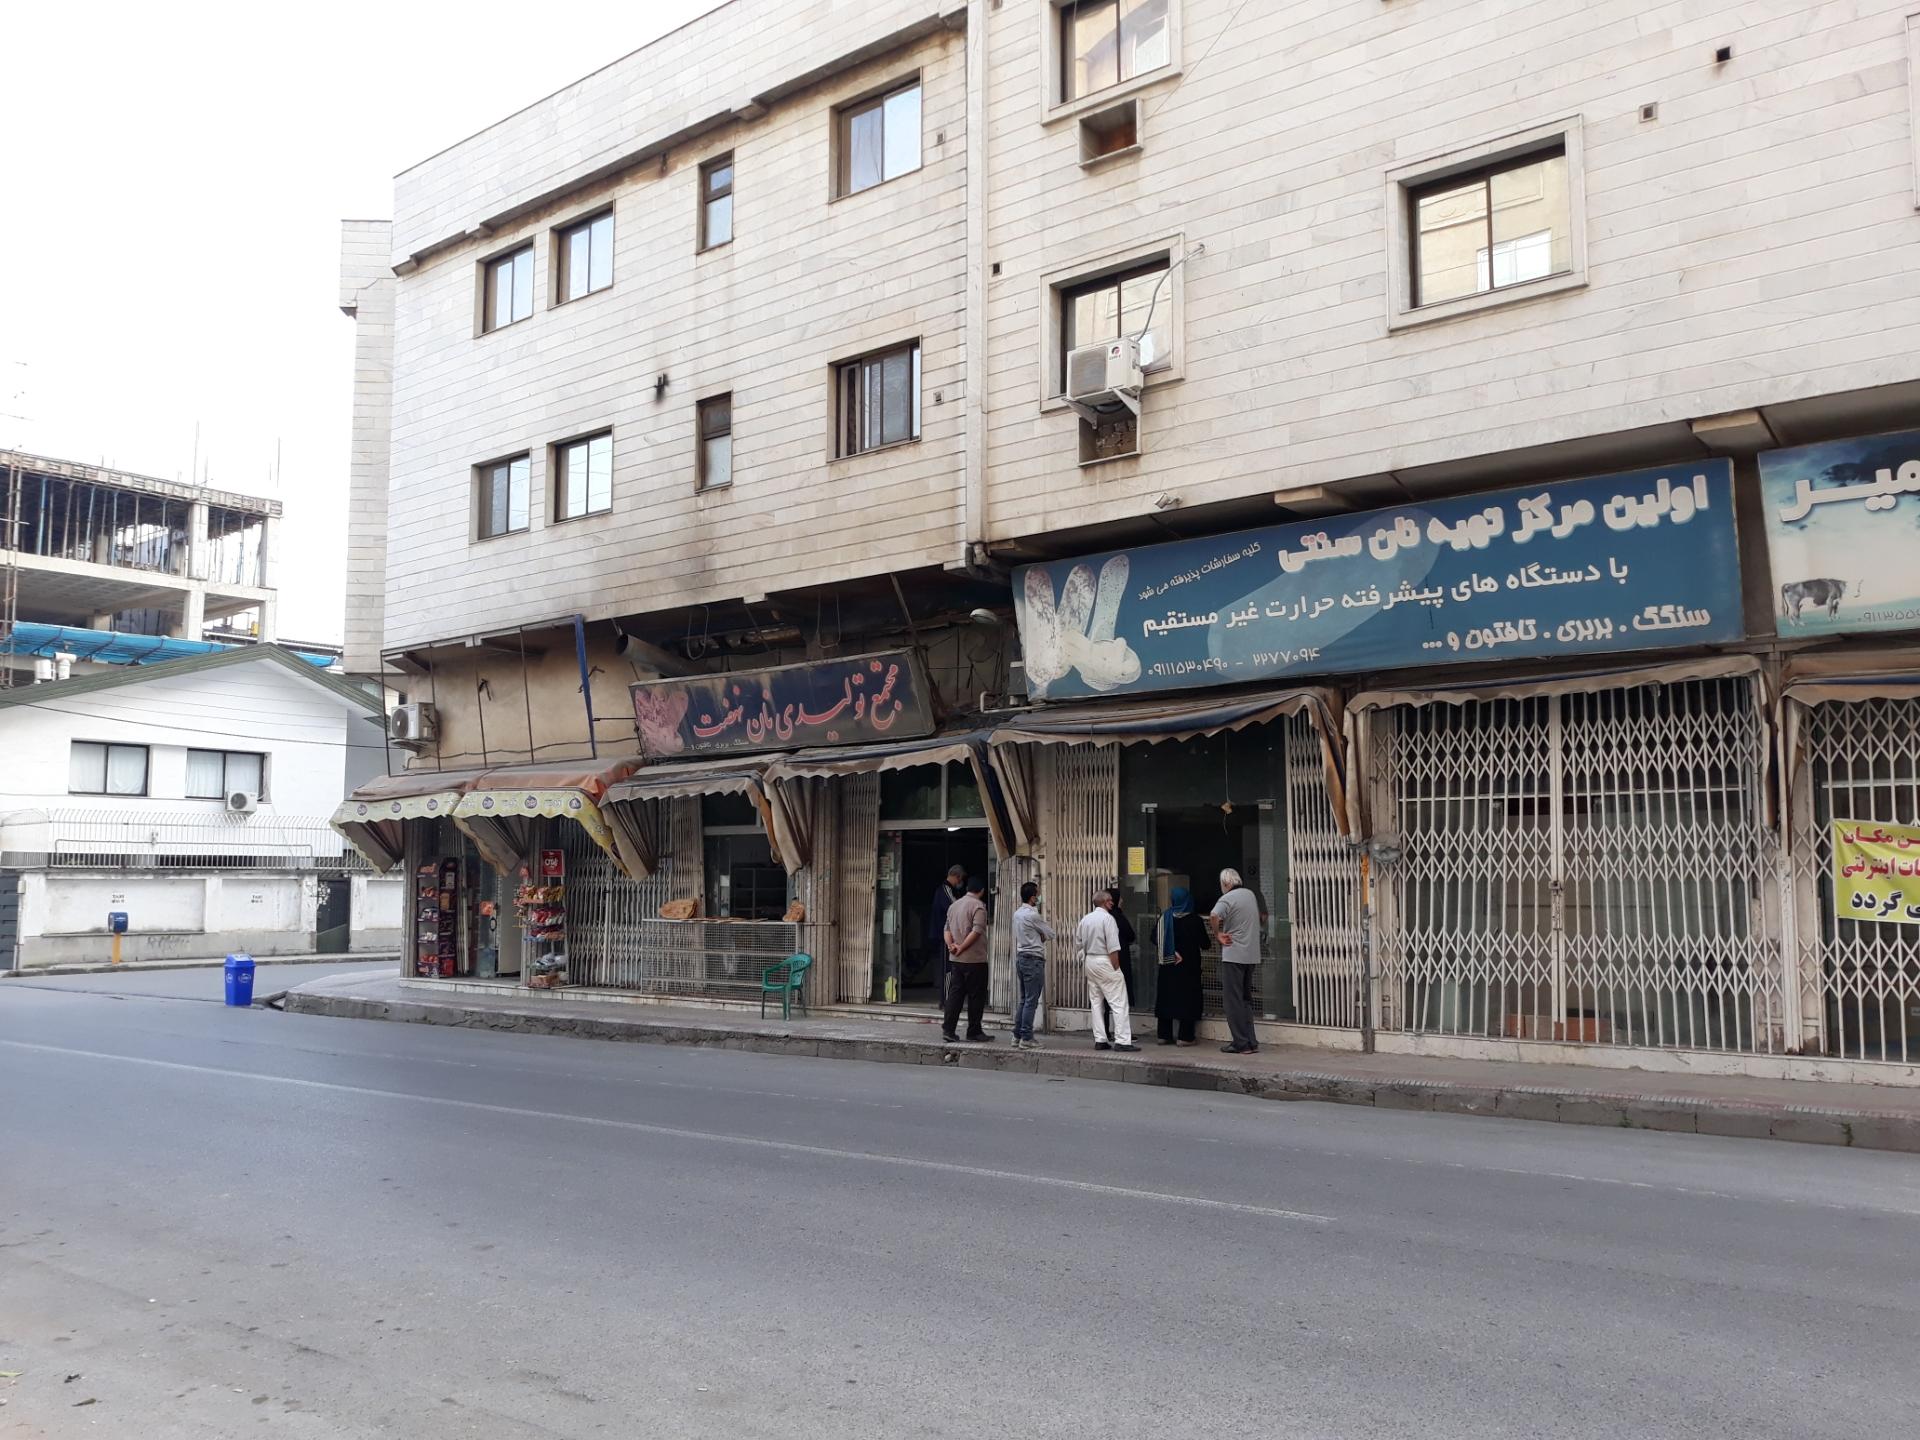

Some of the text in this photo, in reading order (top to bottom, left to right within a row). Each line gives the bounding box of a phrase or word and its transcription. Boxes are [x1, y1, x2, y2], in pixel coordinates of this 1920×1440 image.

[1278, 474, 1709, 573] اولین مرکز تهیه نان سنتی
[1138, 541, 1261, 601] کلیه سفارشات پذیرفته می شود
[1142, 557, 1629, 638] با دستگاه های پیشرفته حرارت غیر مستقیم
[1556, 616, 1614, 642] بربری
[1632, 603, 1711, 631] سنگک
[1447, 630, 1461, 652] و
[1464, 618, 1537, 650] تافتون
[775, 673, 865, 742] تولیدی
[870, 660, 903, 730] مجتمع
[746, 688, 773, 743] نان
[1842, 825, 1893, 844] مکان
[1841, 853, 1897, 880] اینترنتی
[1851, 891, 1903, 917] گردد
